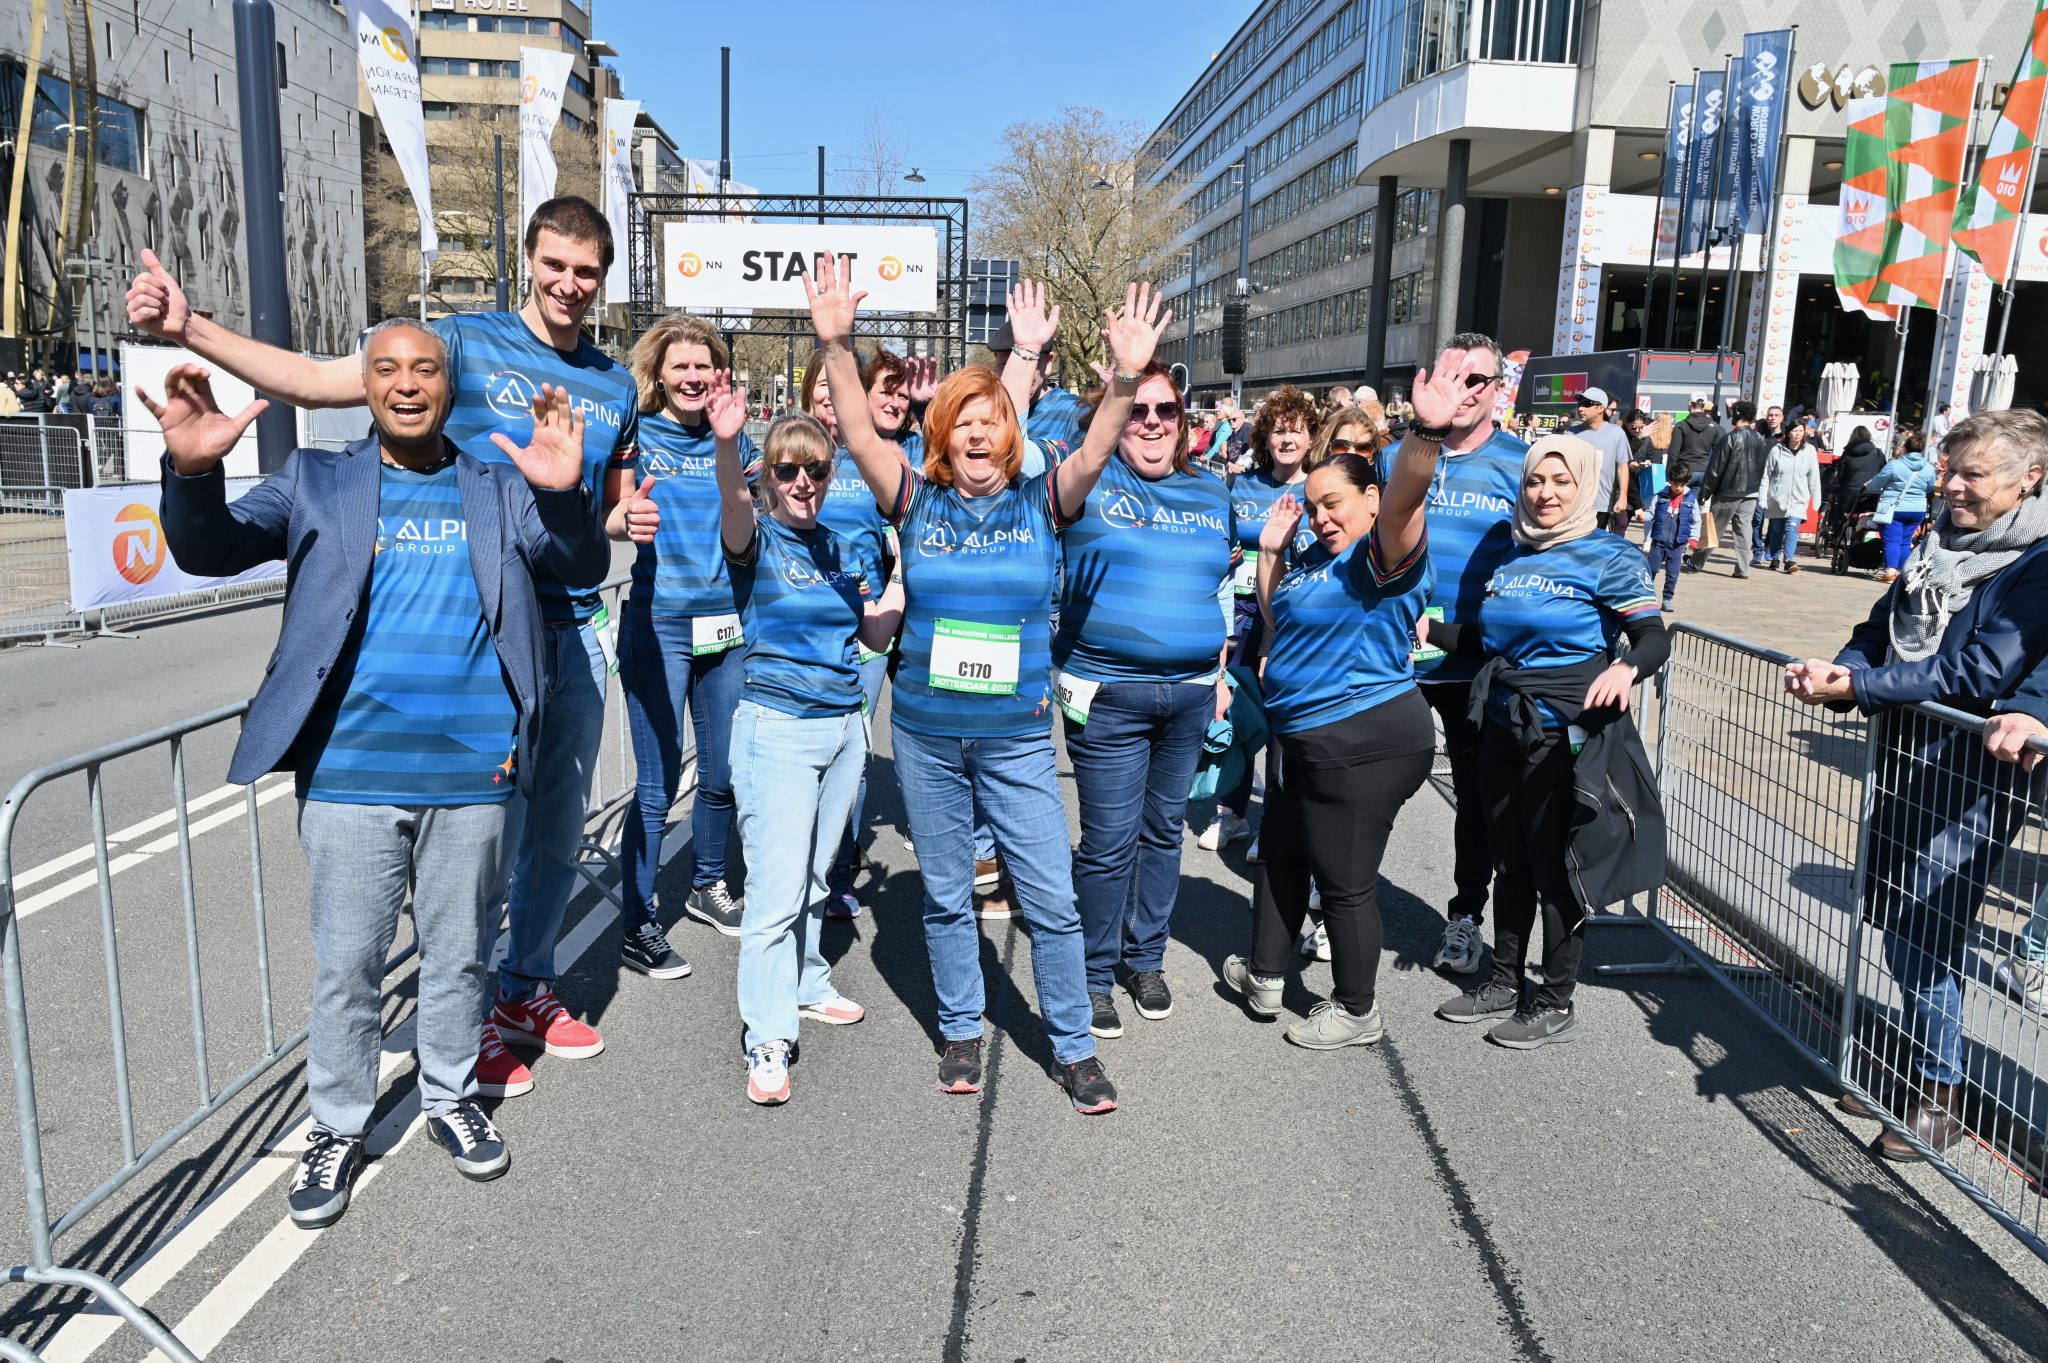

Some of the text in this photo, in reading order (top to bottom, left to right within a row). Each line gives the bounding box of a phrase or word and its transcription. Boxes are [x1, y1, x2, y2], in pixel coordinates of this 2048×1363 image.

[706, 261, 722, 269] NN
[906, 264, 923, 273] NN
[567, 394, 621, 431] LPINA
[682, 456, 716, 470] ALPI
[829, 479, 870, 491] ALPI
[1431, 489, 1510, 514] ALPINA
[1429, 506, 1470, 517] GROUP
[1152, 506, 1226, 535] ALPINA
[396, 519, 467, 541] ALPI
[1152, 523, 1196, 534] GROUP
[963, 527, 1035, 548] ALPINA
[395, 542, 455, 554] GROUP
[961, 546, 1006, 554] GROUP
[1504, 574, 1574, 598] ALPINA
[1500, 590, 1533, 598] GROUP
[717, 625, 735, 641] C171
[935, 626, 950, 634] YOUR
[952, 629, 988, 639] MARATHON
[1423, 650, 1444, 659] 2023
[958, 661, 992, 679] C170
[934, 677, 1013, 692] ROTTERDAM 2023
